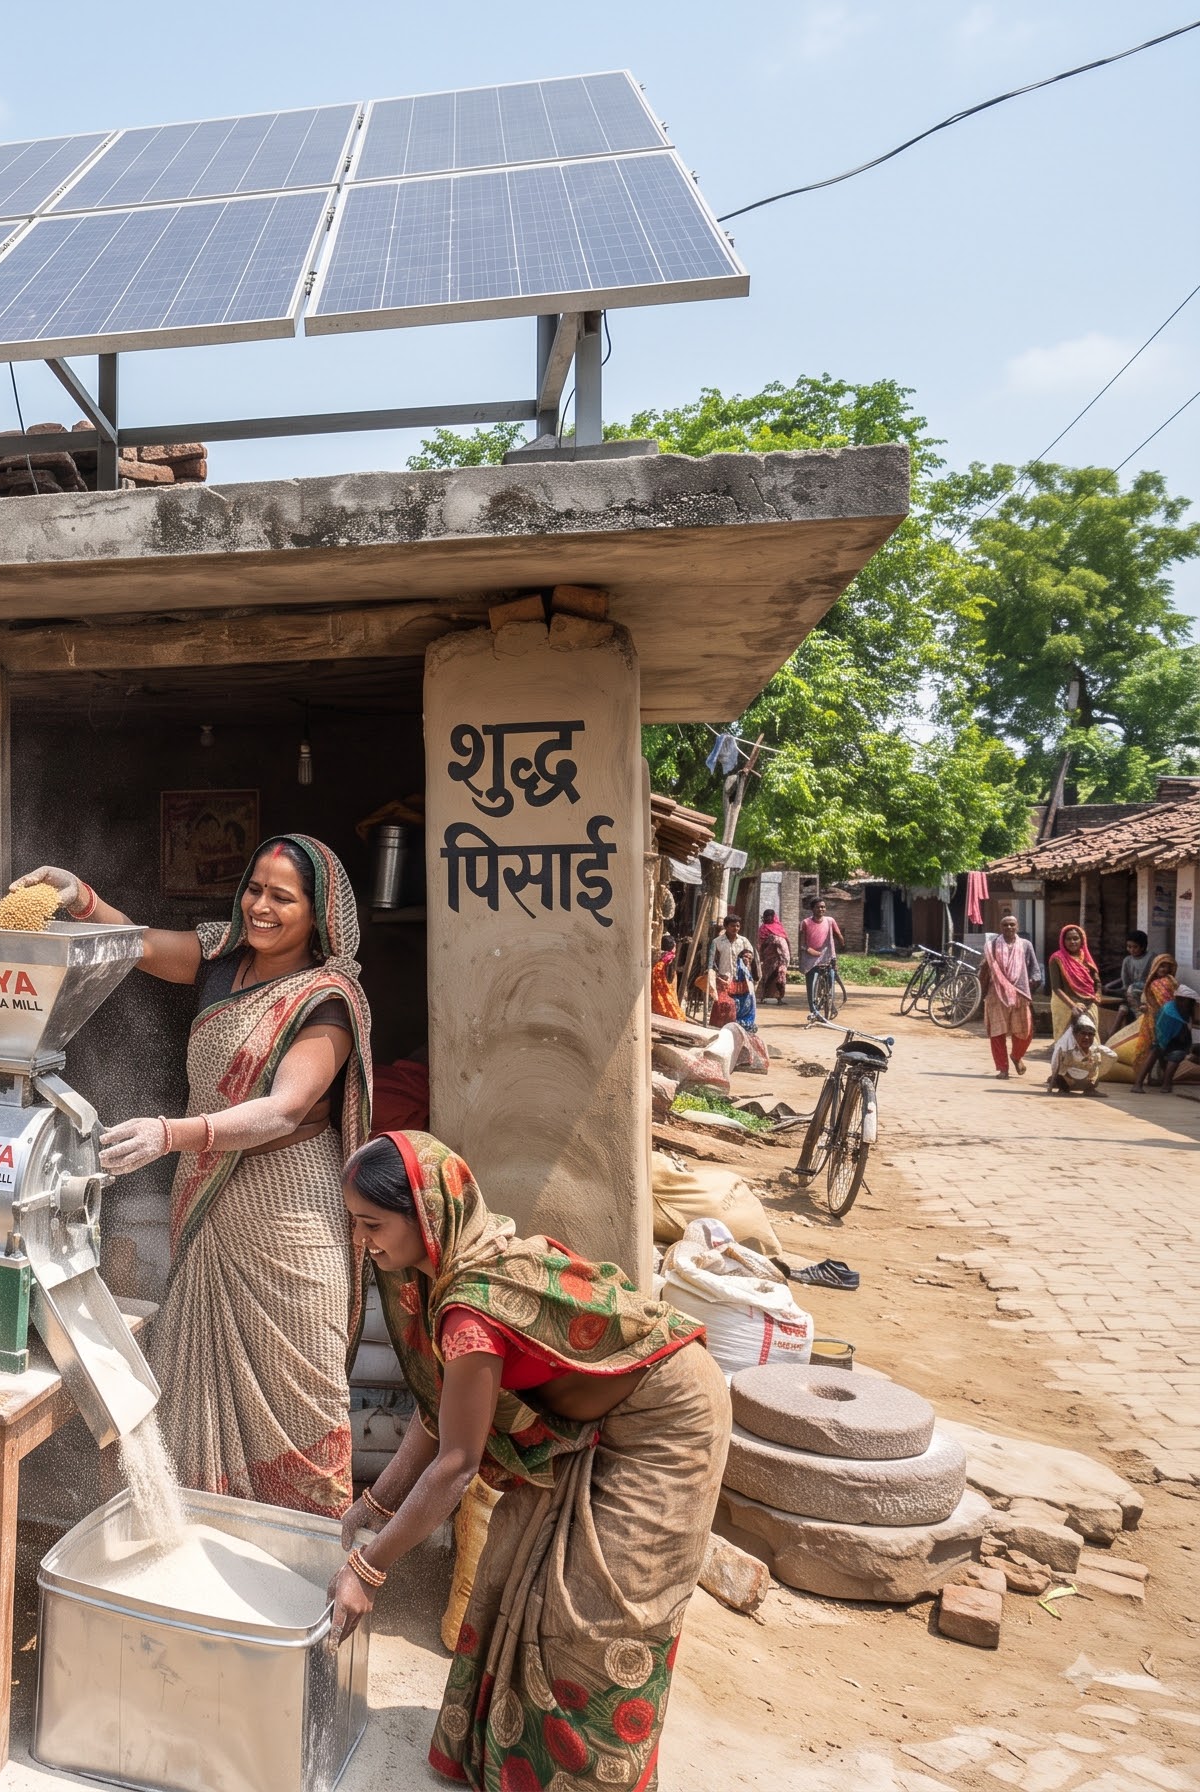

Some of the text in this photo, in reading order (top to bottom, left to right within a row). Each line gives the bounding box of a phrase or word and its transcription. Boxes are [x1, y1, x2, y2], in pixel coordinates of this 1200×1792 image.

[447, 720, 586, 818] शुद्ध
[440, 814, 618, 928] पिसाई
[12, 999, 43, 1012] MILL
